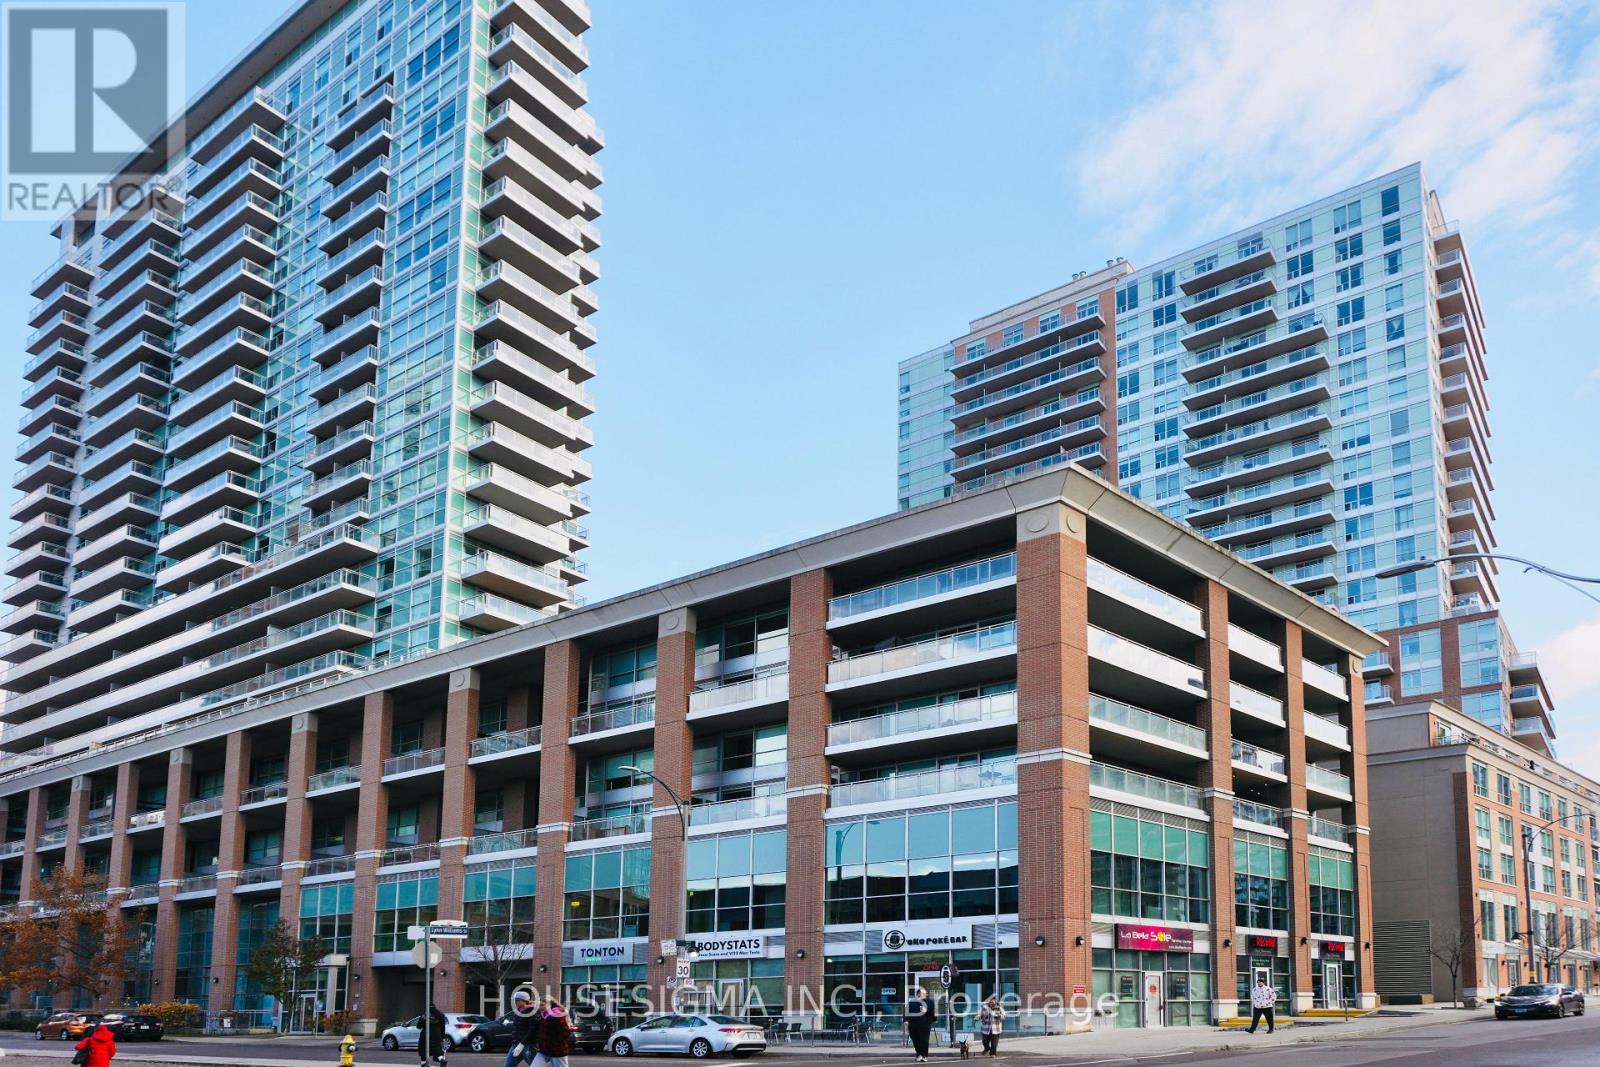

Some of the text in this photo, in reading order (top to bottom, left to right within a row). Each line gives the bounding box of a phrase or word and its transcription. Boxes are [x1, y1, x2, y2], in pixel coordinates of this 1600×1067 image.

[949, 935, 968, 944] BAR
[1150, 931, 1172, 942] Sole
[697, 938, 760, 951] BODYSTATS
[580, 946, 625, 958] TONTON
[677, 966, 689, 975] 30
